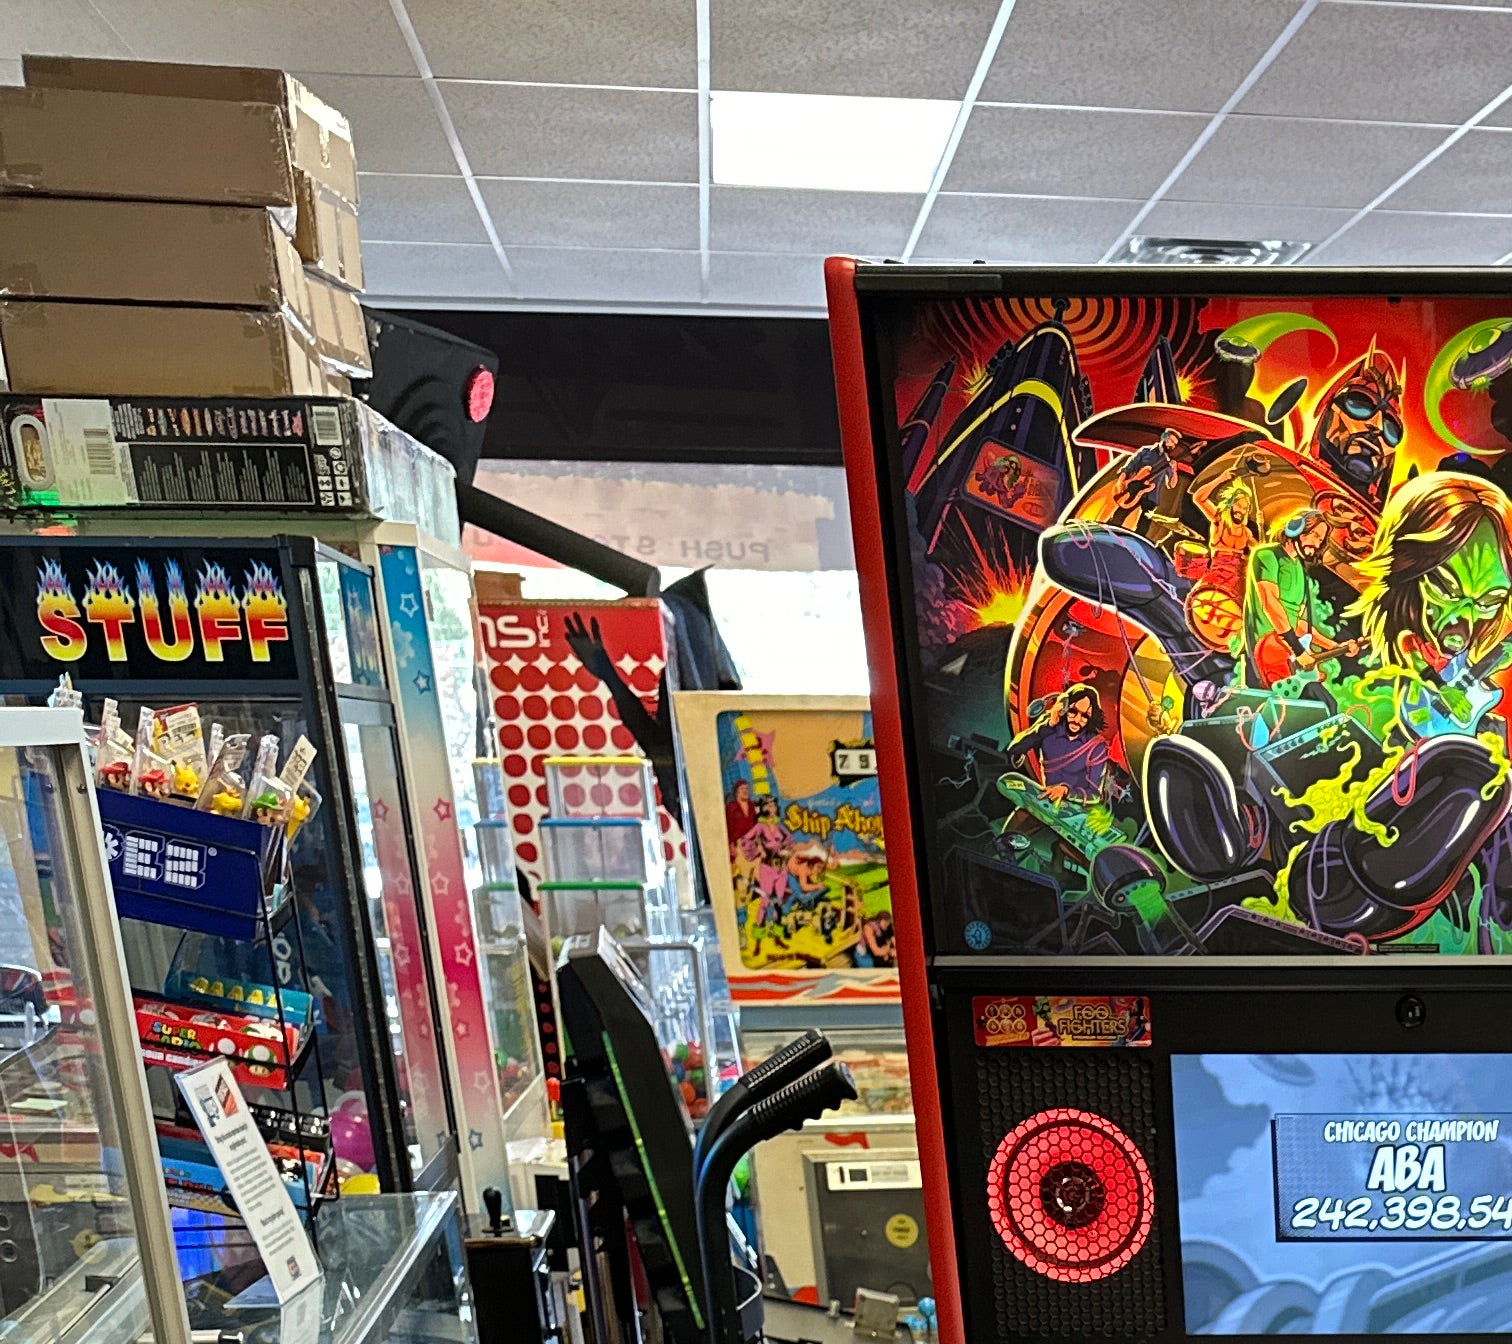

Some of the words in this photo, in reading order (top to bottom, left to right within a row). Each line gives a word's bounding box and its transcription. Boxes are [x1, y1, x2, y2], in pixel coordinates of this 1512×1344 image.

[37, 572, 289, 662] STUFF
[1073, 1004, 1111, 1020] FOO
[152, 1021, 196, 1041] SUPER
[1058, 1019, 1127, 1035] FIGHTERS
[1323, 1119, 1400, 1143] CHICAGO
[1405, 1119, 1500, 1142] CHAMPION
[1366, 1144, 1446, 1192] ABA
